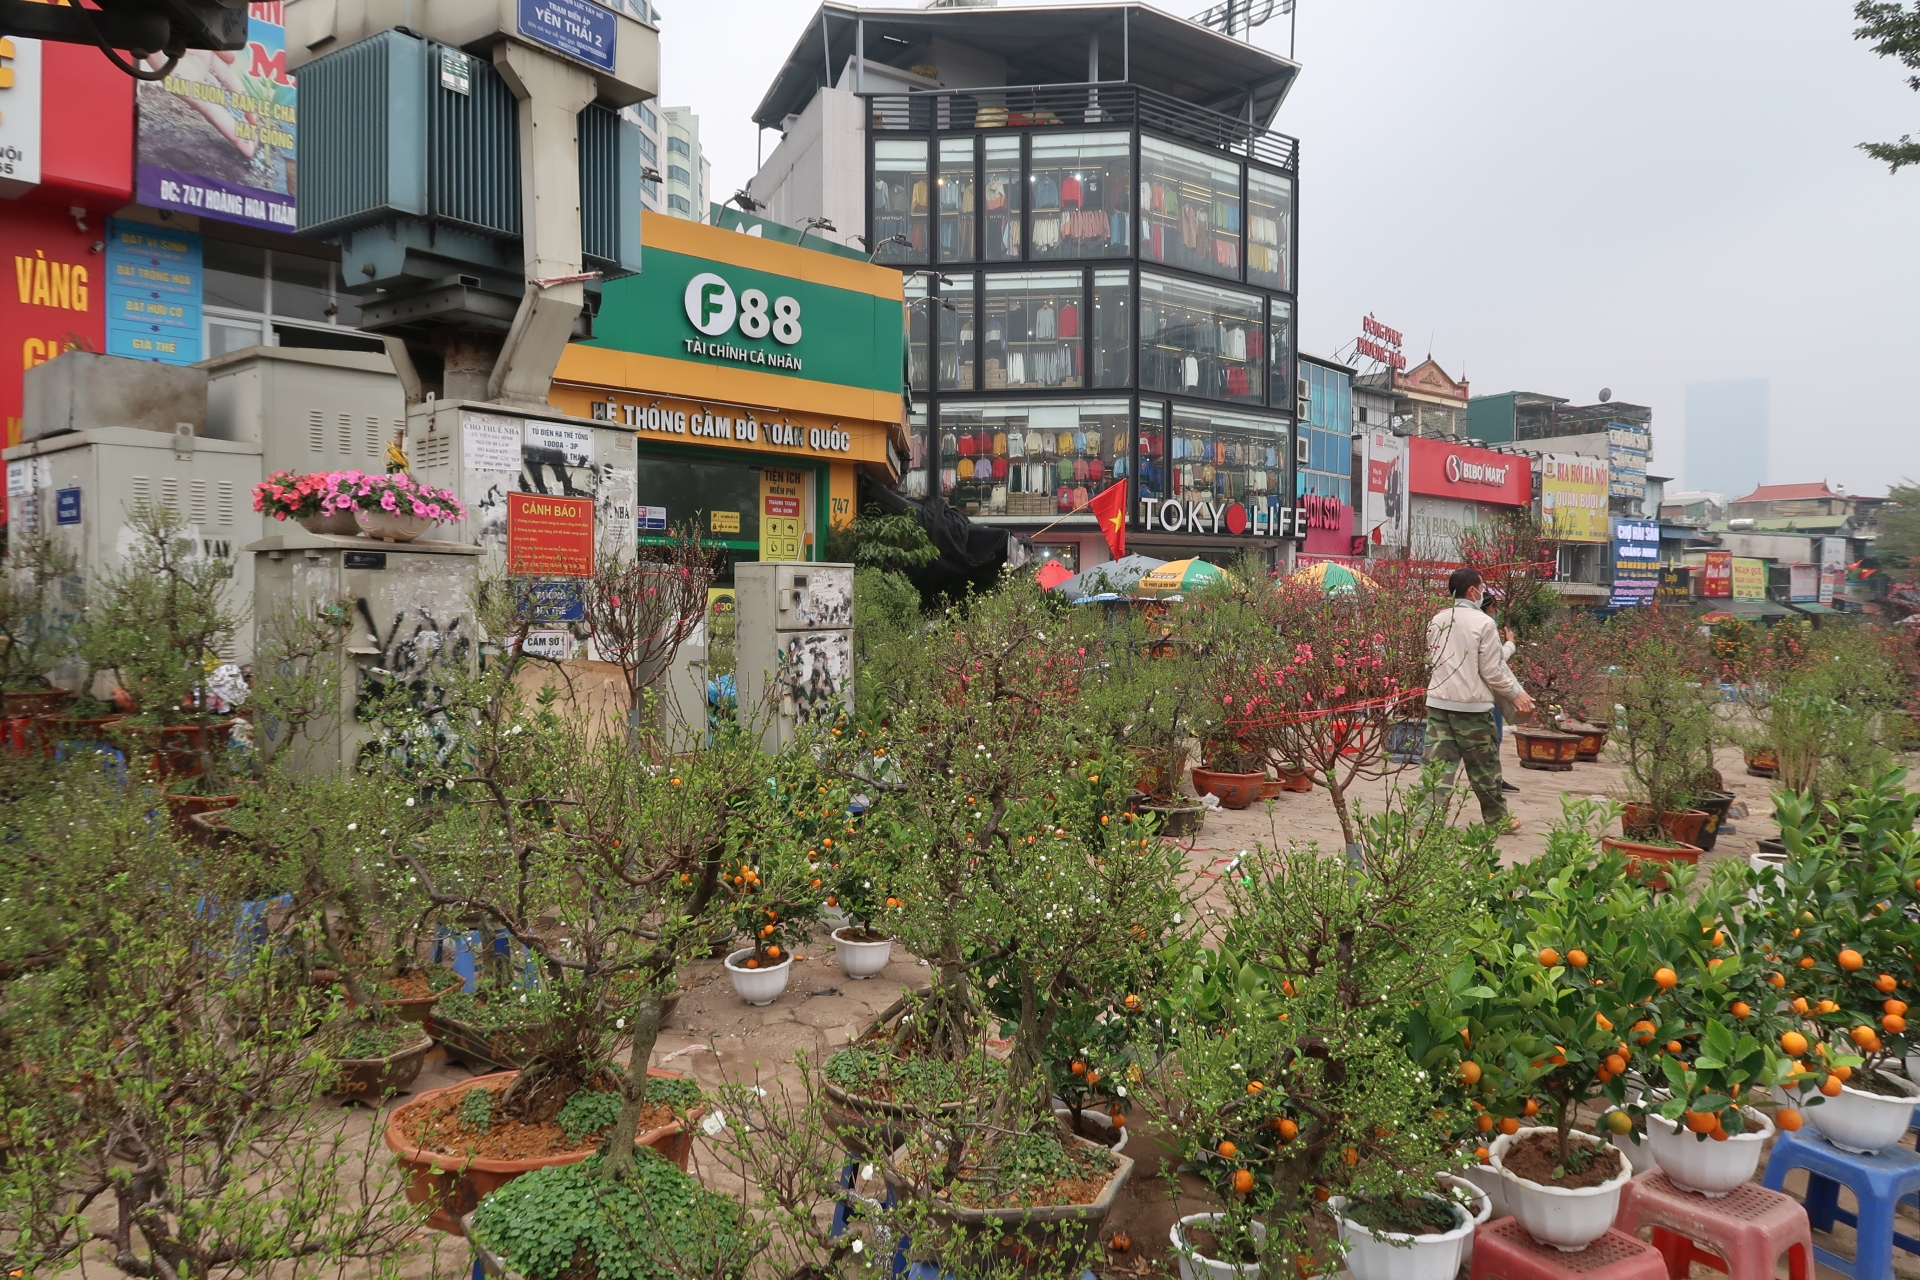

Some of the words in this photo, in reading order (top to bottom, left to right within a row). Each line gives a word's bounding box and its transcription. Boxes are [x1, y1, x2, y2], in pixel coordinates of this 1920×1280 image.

[535, 6, 561, 29] YÊN
[564, 19, 592, 43] THÁI
[595, 34, 603, 48] 2
[164, 74, 189, 97] BÁN
[231, 90, 255, 113] BÁN
[235, 122, 257, 144] HẠT
[182, 184, 204, 207] 747
[205, 188, 243, 215] HOÀNG
[244, 197, 267, 221] HOA
[15, 249, 89, 312] VÀNG
[172, 274, 191, 286] HOA
[685, 273, 802, 345] F88
[685, 336, 706, 354] TÀI
[709, 342, 747, 362] CHÍNH
[750, 349, 765, 365] CÁ
[768, 353, 802, 371] NHÂN
[464, 423, 481, 431] CHO
[540, 428, 553, 437] ĐIỆN
[622, 401, 686, 434] THỐNG
[690, 406, 731, 439] CẦM
[735, 411, 759, 442] ĐỒ
[761, 418, 805, 447] TOÀN
[810, 422, 851, 452] QUỐC
[543, 440, 564, 449] 1000A
[570, 442, 579, 450] 3P
[764, 468, 784, 484] TIỆN
[786, 468, 801, 484] ÍCH
[1463, 463, 1482, 480] BIBO
[1485, 465, 1506, 485] MART
[786, 485, 796, 496] PHÍ
[522, 501, 552, 516] CẢNH
[554, 504, 576, 518] BÁO
[831, 497, 850, 514] 747
[1253, 505, 1307, 538] LIFE
[527, 635, 546, 646] CẤM
